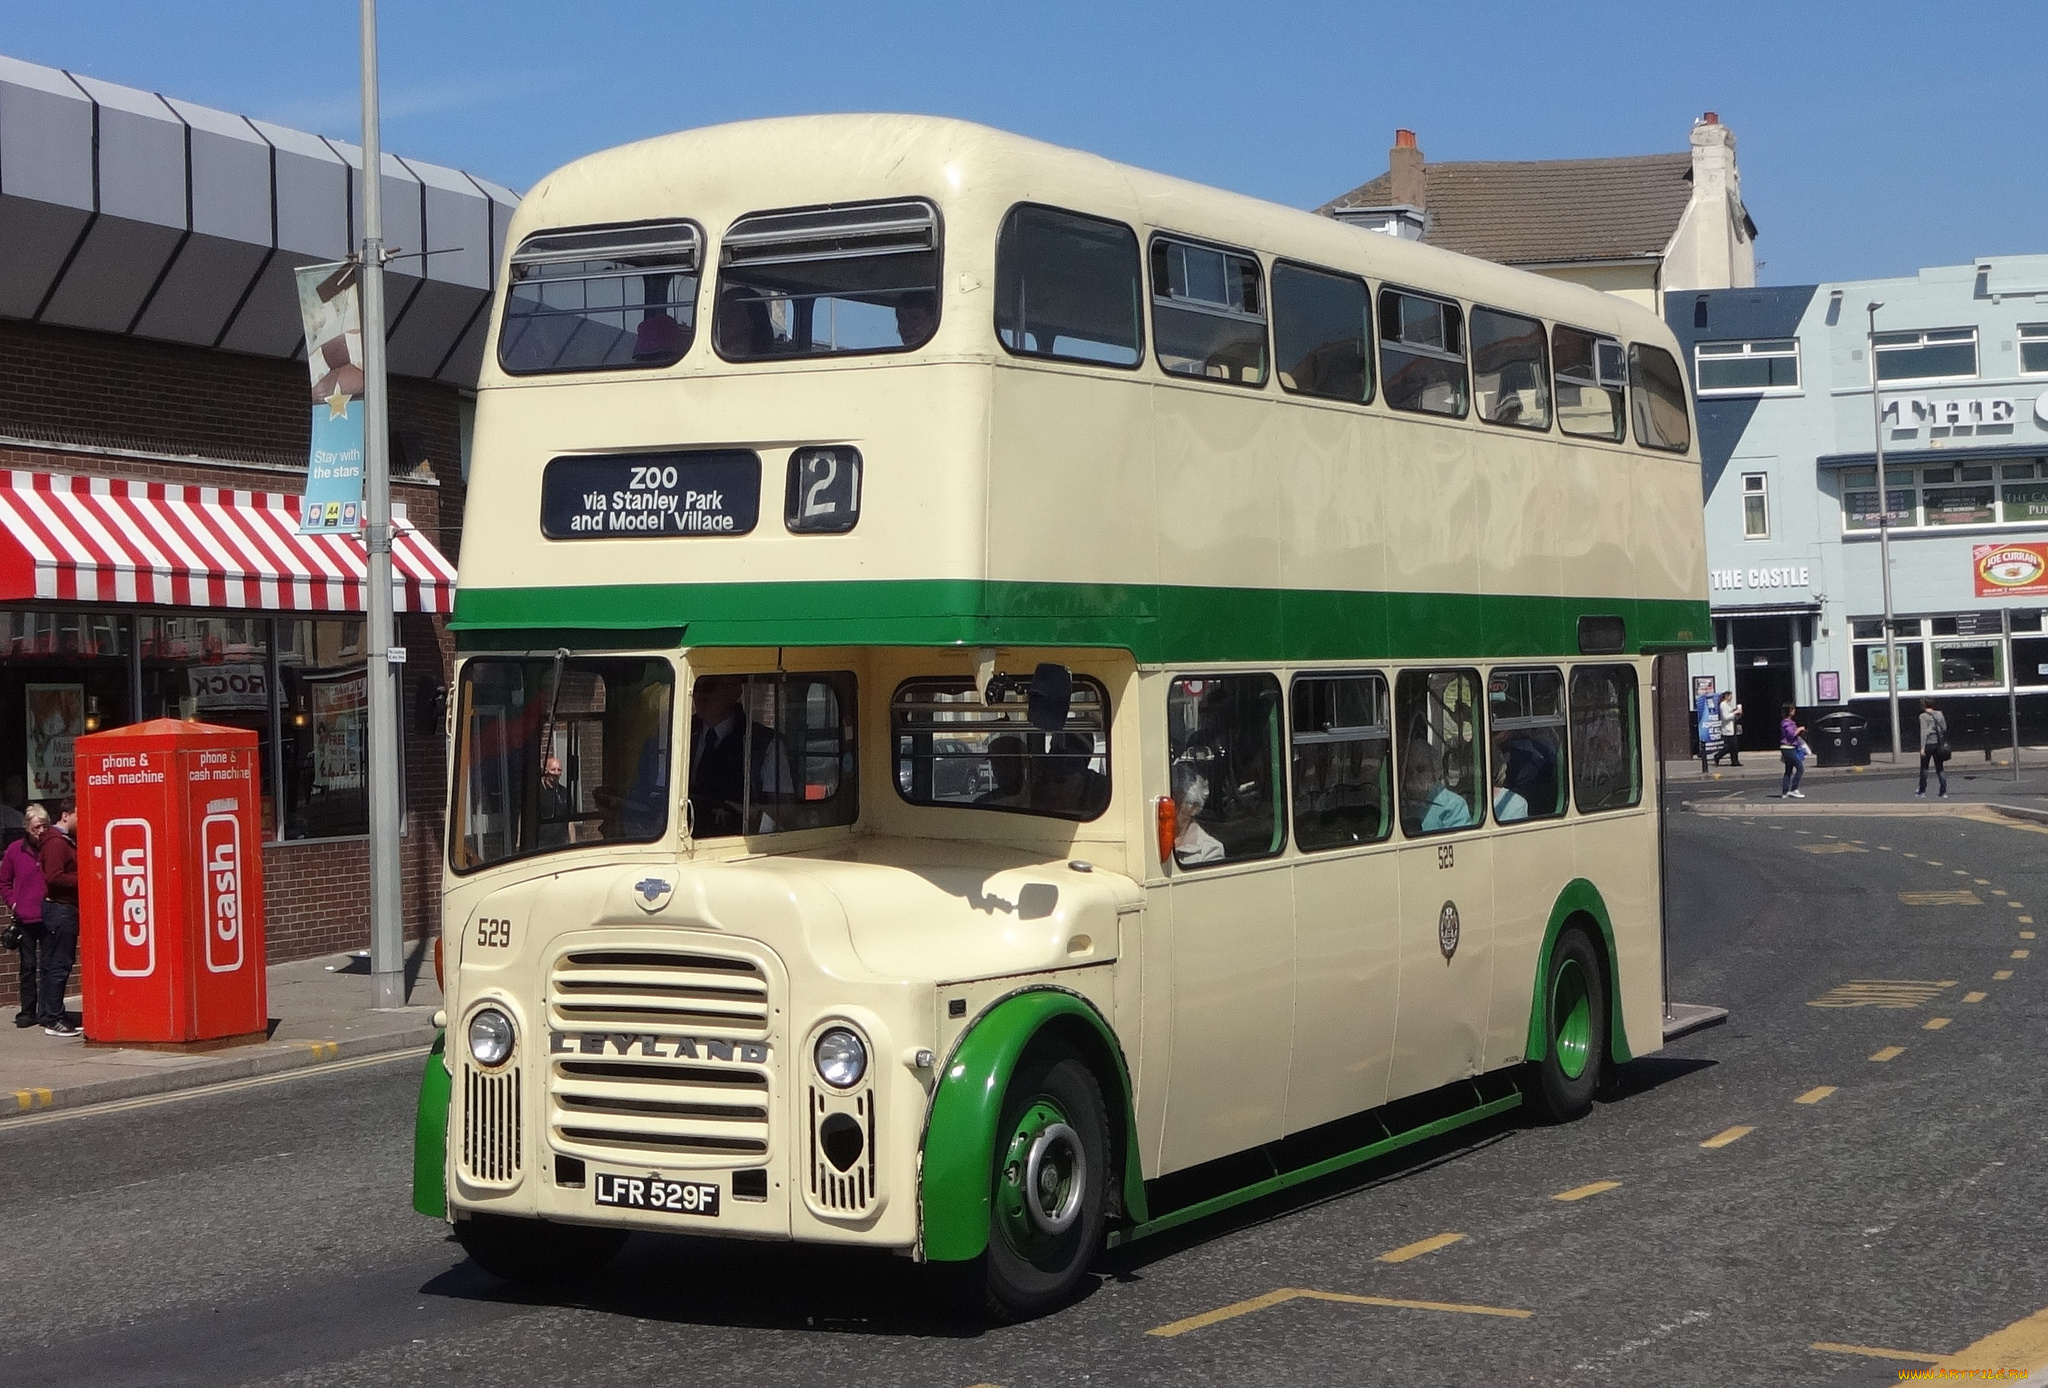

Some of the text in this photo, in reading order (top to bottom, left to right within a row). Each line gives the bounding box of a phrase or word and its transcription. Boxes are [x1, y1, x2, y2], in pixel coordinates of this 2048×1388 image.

[1883, 397, 2015, 429] THE
[314, 449, 360, 464] Stay with
[314, 466, 359, 478] the stars
[630, 467, 678, 489] ZOO
[583, 490, 723, 514] via Stanley Park
[571, 511, 734, 532] and Model Village
[1986, 554, 2002, 568] JOE
[2002, 551, 2037, 564] CURRAN
[1712, 567, 1809, 589] THE CASTLE
[103, 753, 149, 771] phone &
[200, 751, 237, 766] phone &
[89, 770, 164, 786] cash machine
[189, 766, 250, 781] cash machine
[1438, 845, 1454, 869] 529
[114, 848, 147, 946] cash
[209, 844, 237, 941] cash
[477, 918, 511, 948] 529
[551, 1032, 770, 1063] LEYLAND
[598, 1176, 717, 1211] LFR 529F
